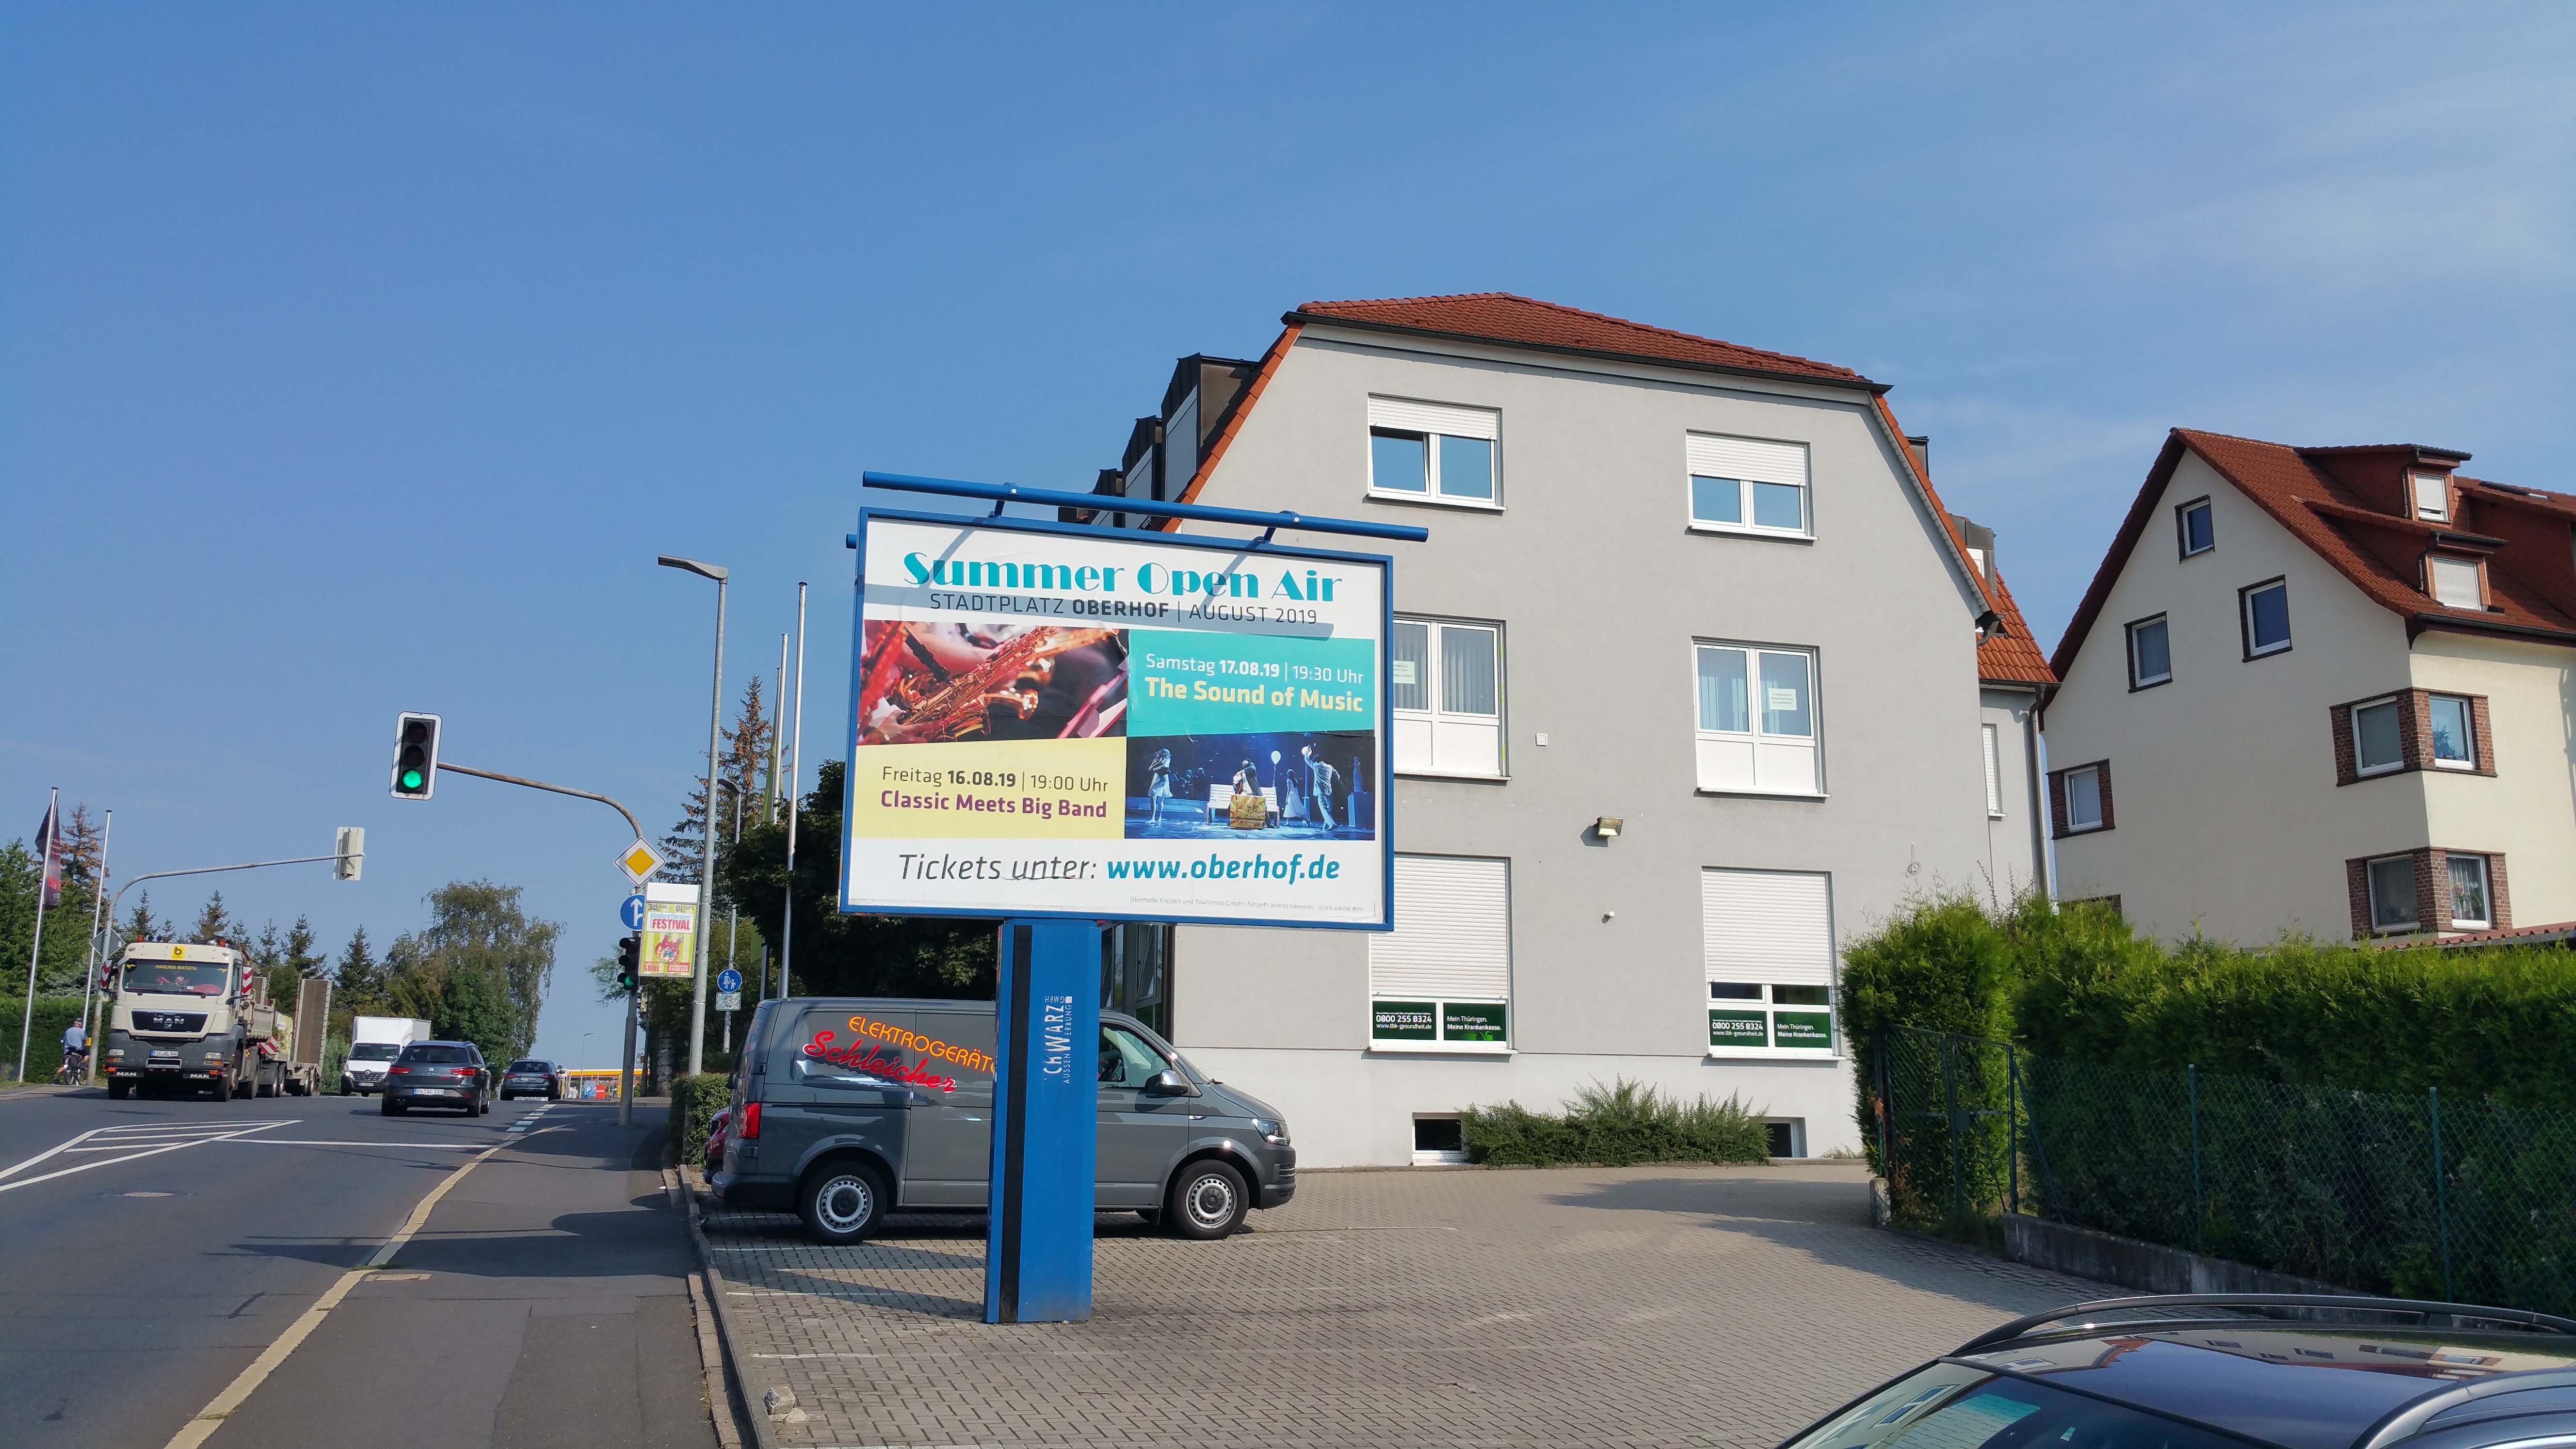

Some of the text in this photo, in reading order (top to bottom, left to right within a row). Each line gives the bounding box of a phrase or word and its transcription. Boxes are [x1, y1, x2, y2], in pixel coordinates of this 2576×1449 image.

[904, 552, 1342, 602] Summer Open Air
[930, 593, 1317, 625] STADTPLATZ OBERHOF AUGUST 2019
[1146, 653, 1363, 684] Samstag 17.08.19 19:30 Uhr
[1145, 676, 1363, 712] The Sound of Music
[883, 766, 1109, 792] Freitag 16.08.19 19:00 Uhr
[881, 790, 1107, 820] Classic Meets Big Band
[899, 853, 1340, 885] Tickets unter: www.oberhof.de
[652, 918, 690, 930] FESTIVAL
[803, 1030, 957, 1094] Schleicher
